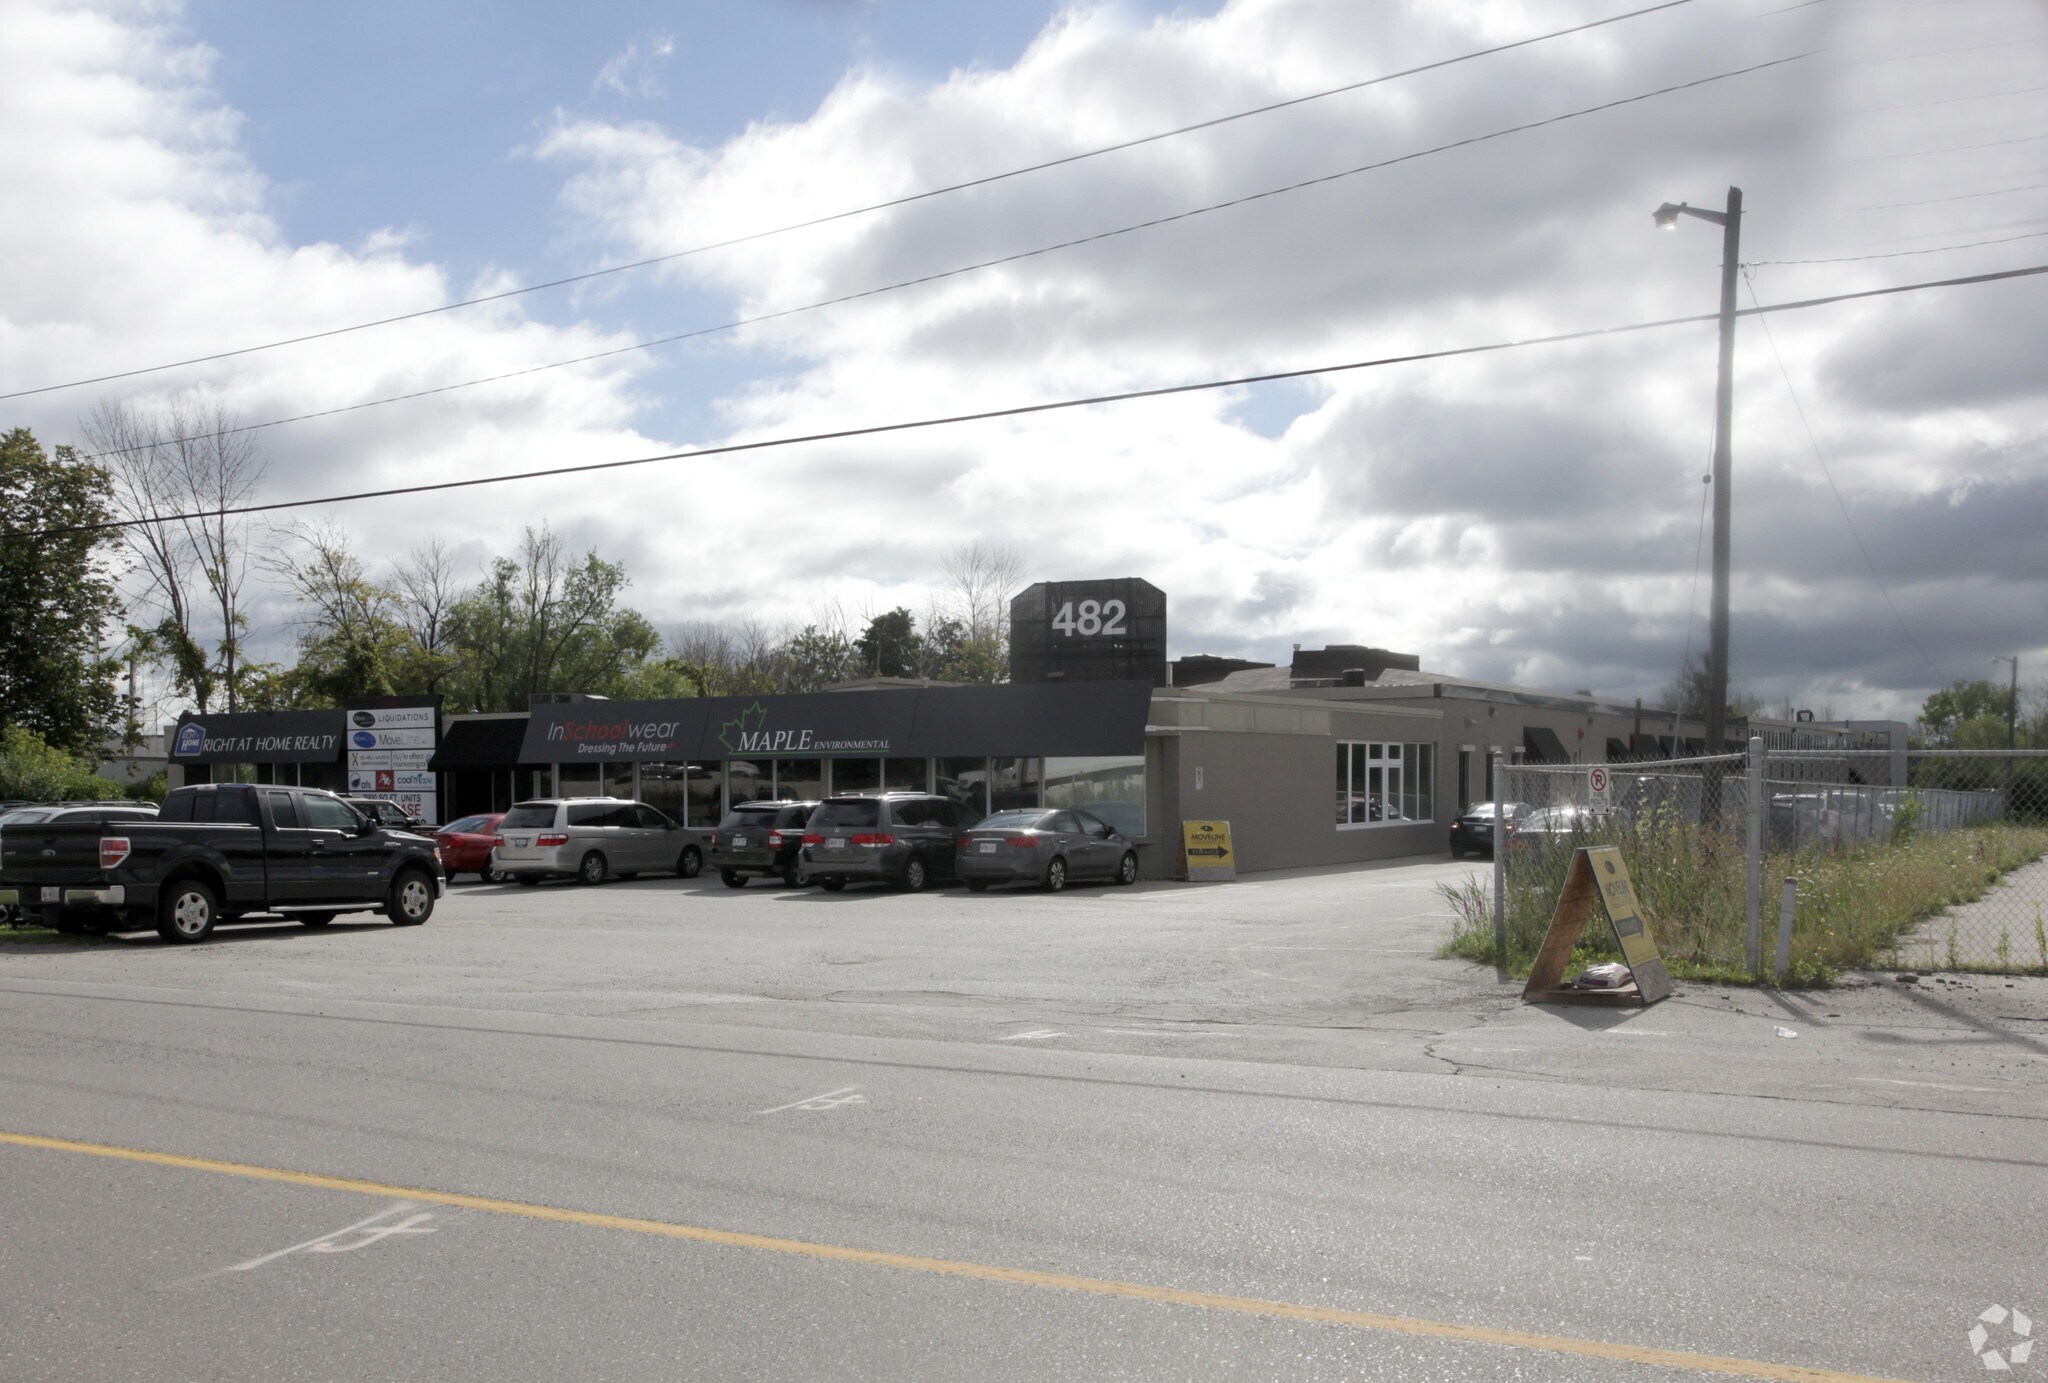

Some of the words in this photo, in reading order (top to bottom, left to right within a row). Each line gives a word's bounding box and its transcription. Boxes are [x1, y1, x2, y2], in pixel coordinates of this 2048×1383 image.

[1052, 599, 1126, 637] 482
[378, 713, 429, 722] LIQUIDATIONS
[547, 718, 679, 742] InSchoolwear
[202, 738, 236, 752] RIGHT
[237, 737, 253, 751] AT
[255, 736, 291, 751] HOME
[294, 735, 336, 750] REALTY
[379, 732, 420, 746] MoveLine
[737, 729, 813, 752] MAPLE
[814, 739, 890, 750] ENVIRONMENTAL
[577, 742, 617, 754] Dressing
[618, 742, 635, 753] The
[636, 741, 667, 752] Future
[401, 794, 421, 802] UNITS
